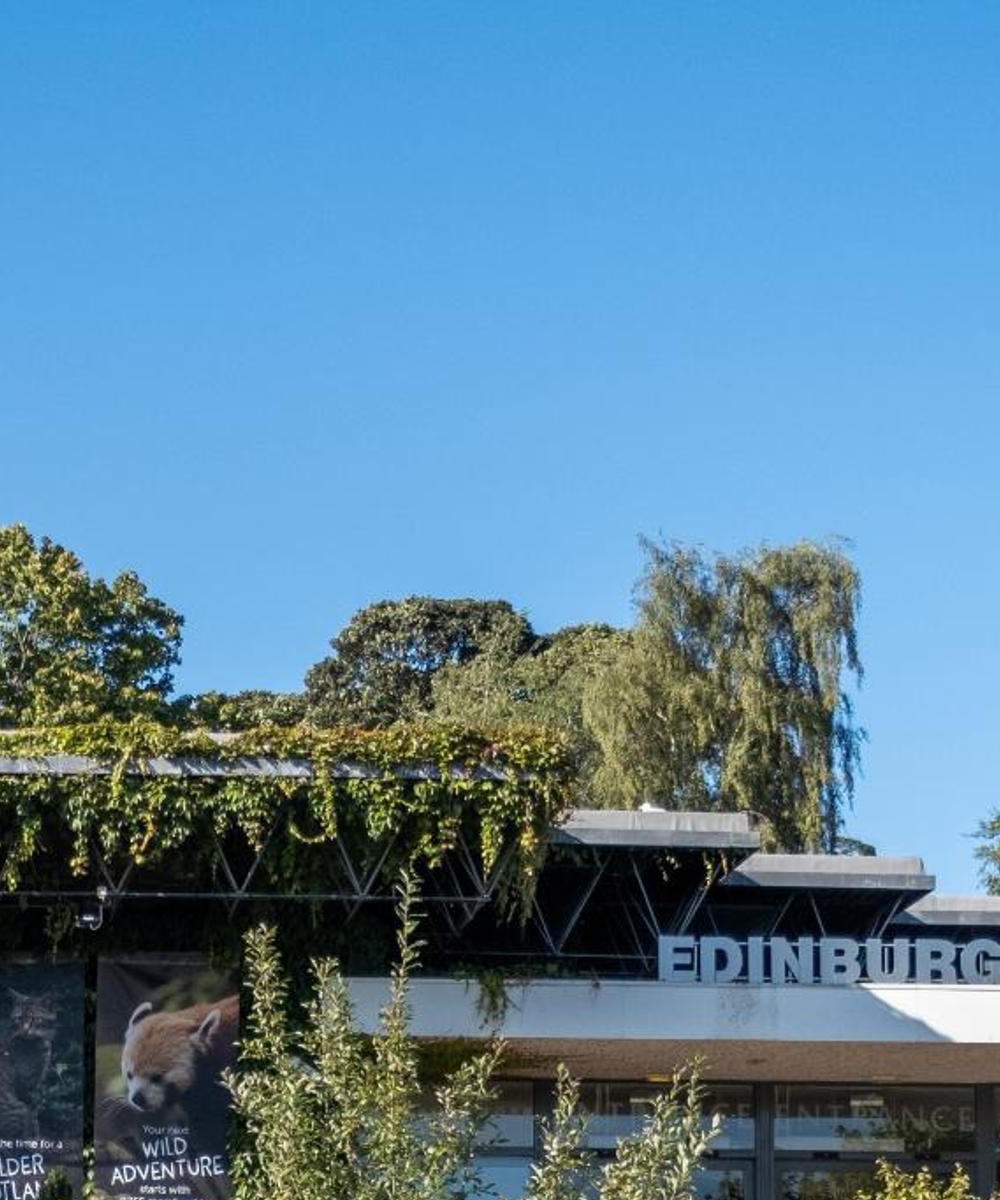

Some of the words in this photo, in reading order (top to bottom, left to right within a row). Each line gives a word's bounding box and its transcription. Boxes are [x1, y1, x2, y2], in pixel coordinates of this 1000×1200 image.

[142, 1125, 164, 1135] Your
[16, 1139, 38, 1149] time
[40, 1139, 55, 1149] for
[56, 1141, 63, 1149] a
[142, 1137, 188, 1159] WILD
[111, 1155, 225, 1186] ADVENTURE
[140, 1185, 167, 1195] starts
[168, 1185, 192, 1195] with
